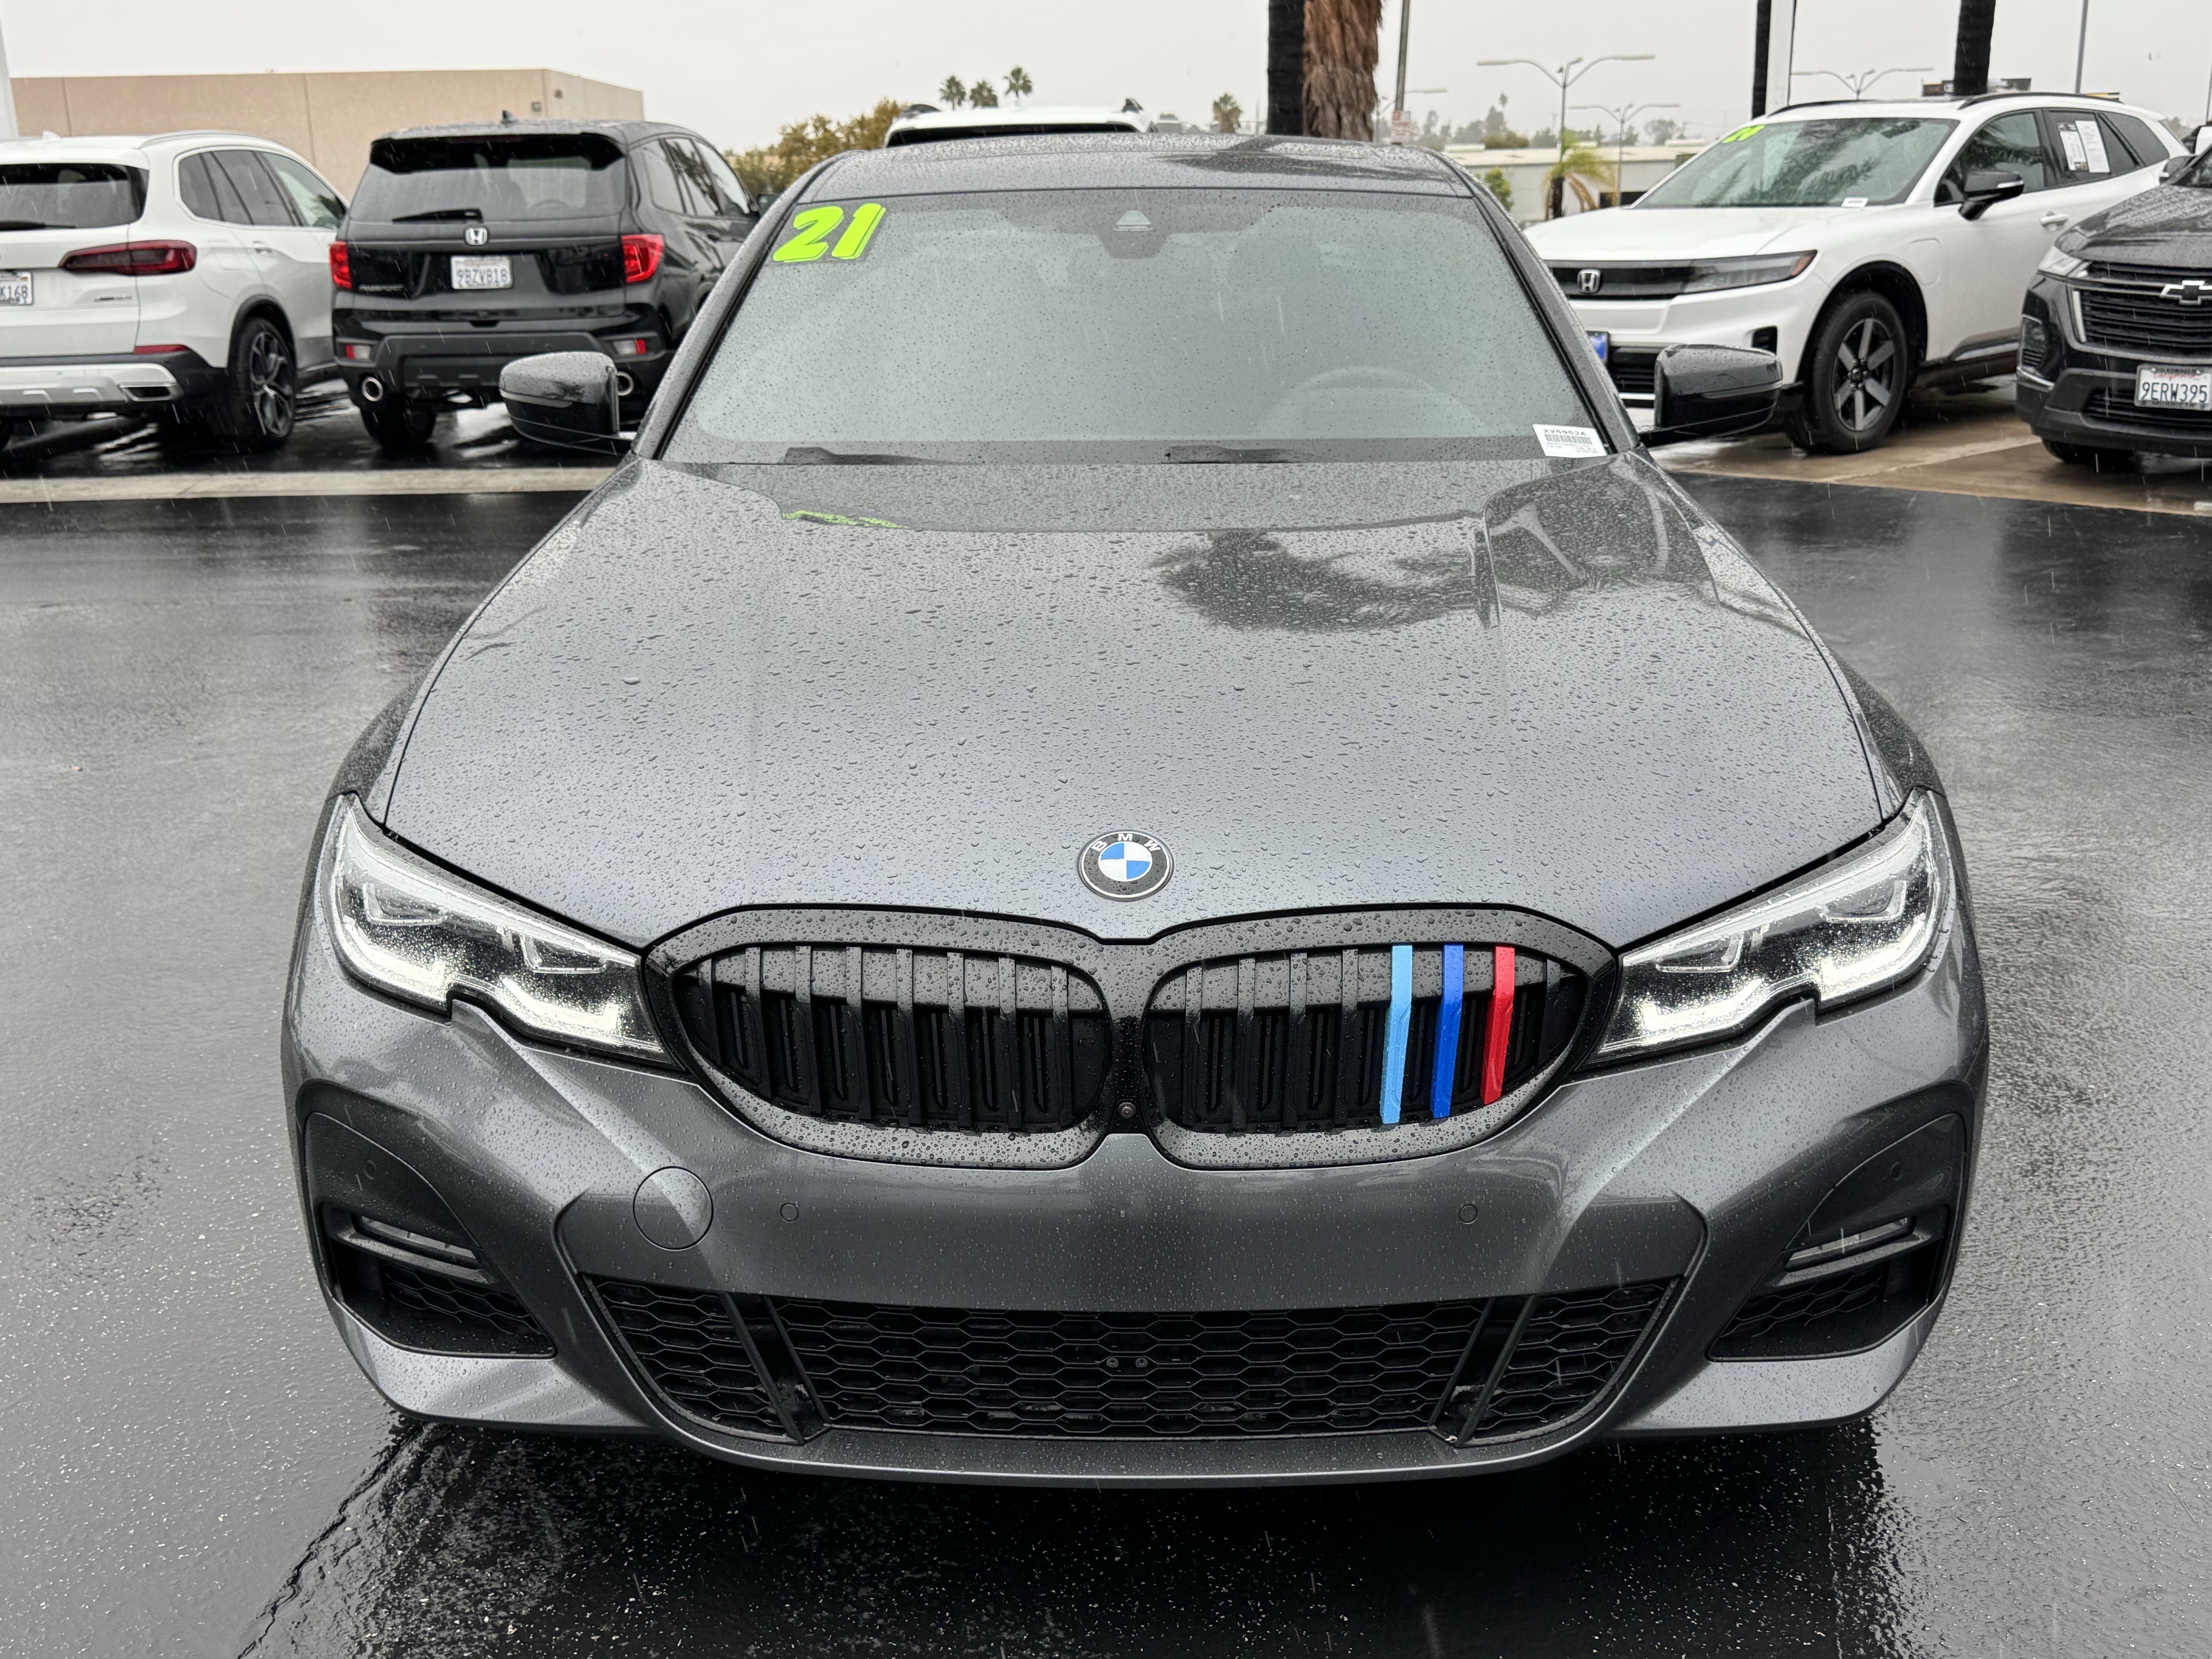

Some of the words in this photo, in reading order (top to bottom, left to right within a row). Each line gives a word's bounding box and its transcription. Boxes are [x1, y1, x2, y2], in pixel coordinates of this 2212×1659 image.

[773, 203, 886, 263] 21
[2142, 382, 2207, 404] 9ERW395
[1091, 833, 1161, 852] BMW
